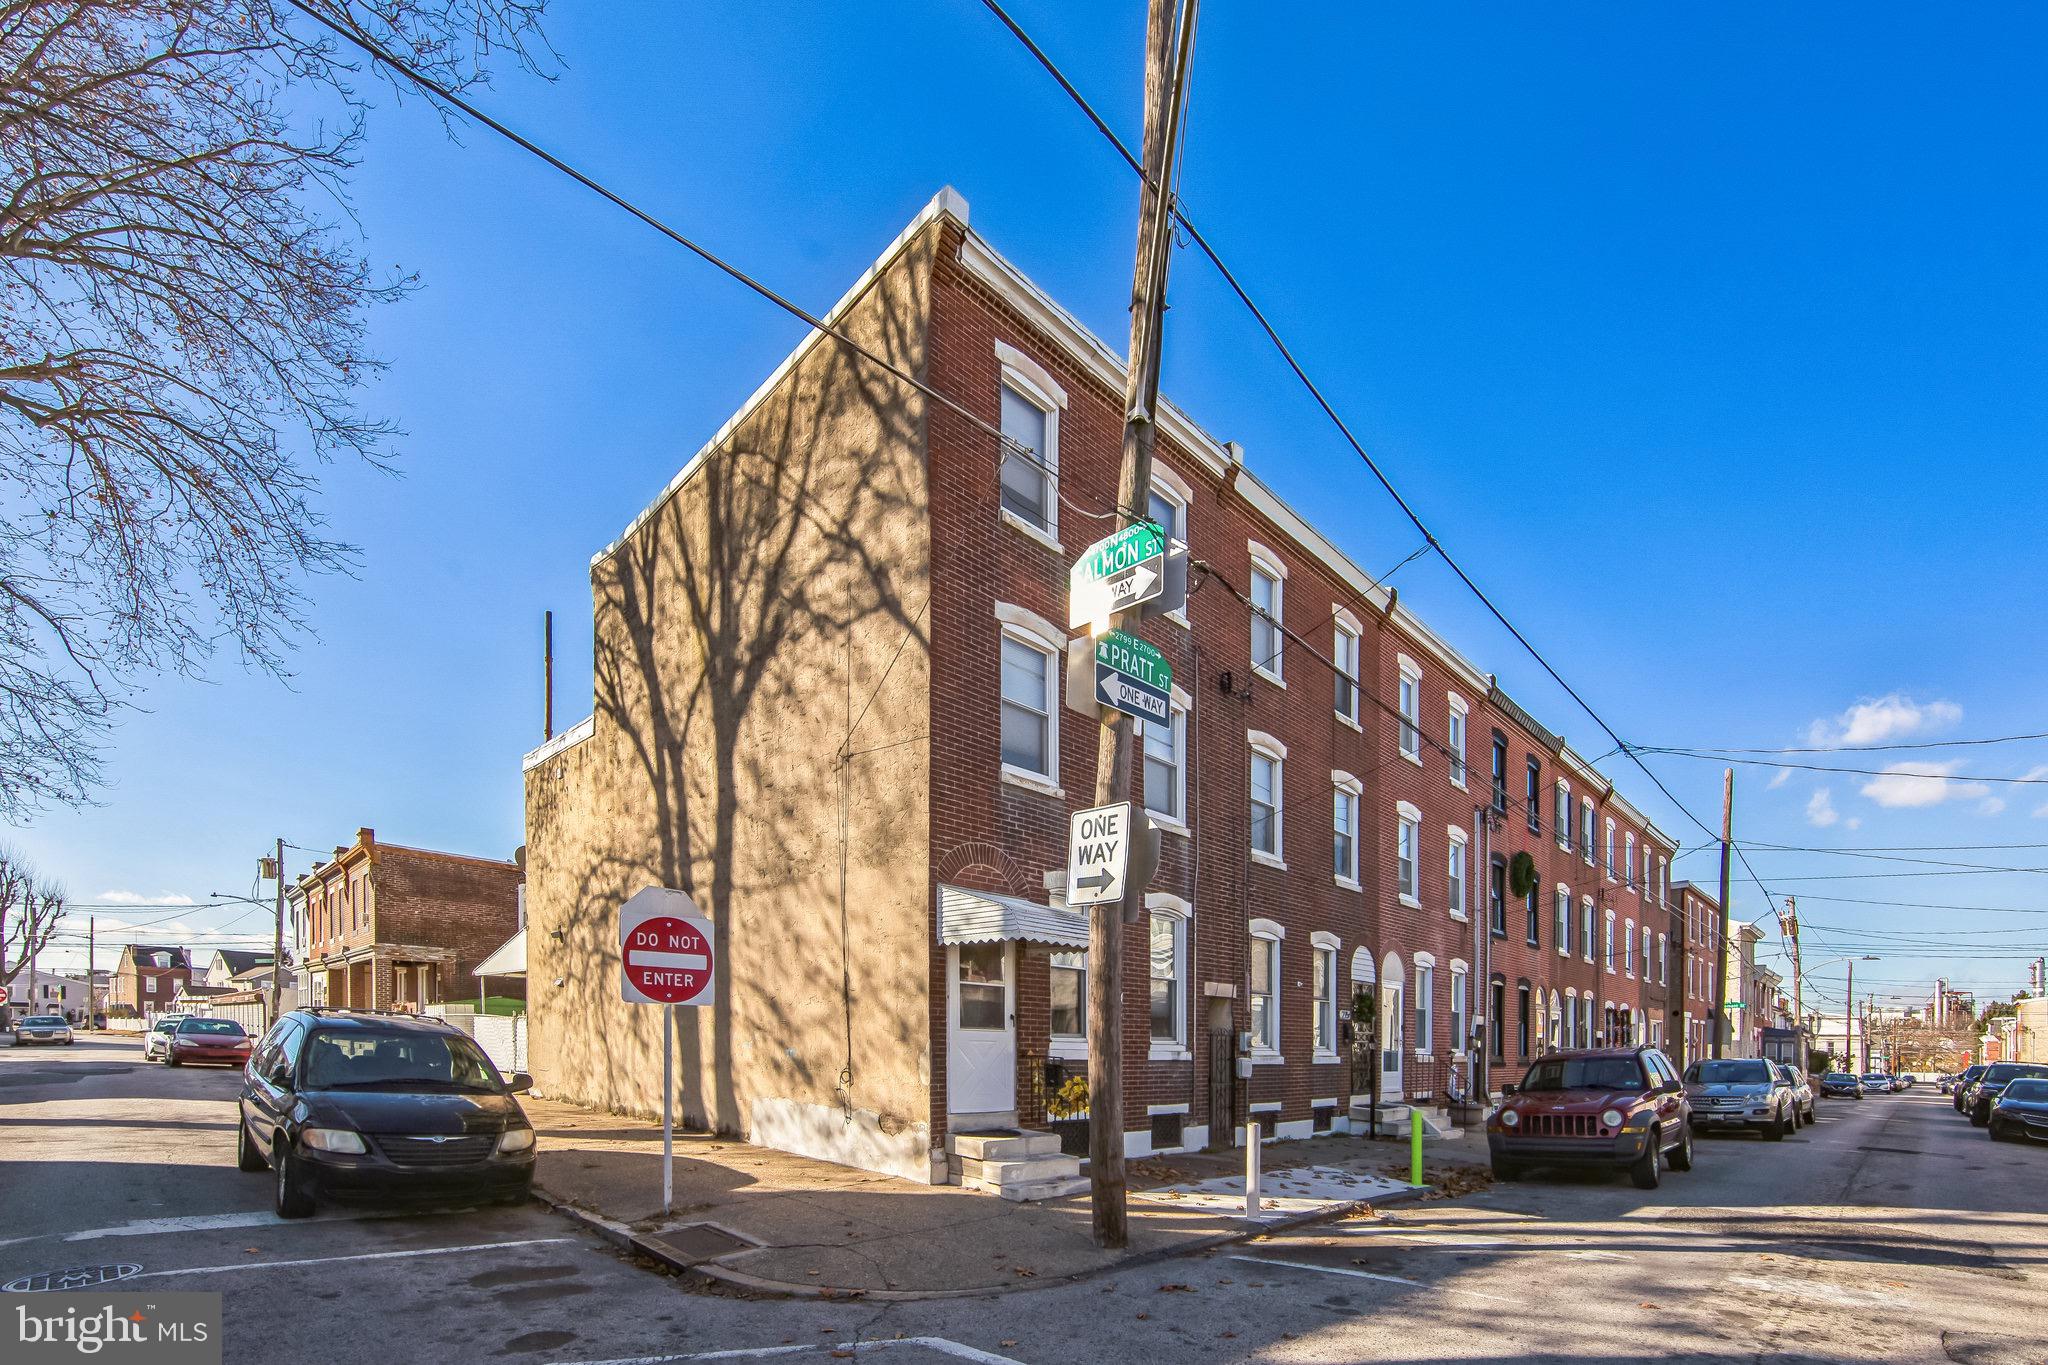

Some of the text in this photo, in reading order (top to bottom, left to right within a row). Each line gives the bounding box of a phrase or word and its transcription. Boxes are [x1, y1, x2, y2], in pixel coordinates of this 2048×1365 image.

[1110, 535, 1118, 548] N
[1079, 538, 1160, 583] ALMON ST
[1115, 631, 1156, 657] 2799 E 2700
[1111, 644, 1169, 690] PRATT ST
[1120, 684, 1163, 715] ONE WAY
[1081, 814, 1118, 840] ONE
[1078, 840, 1118, 866] WAY
[637, 932, 700, 950] DO NOT
[643, 971, 694, 988] ENTER
